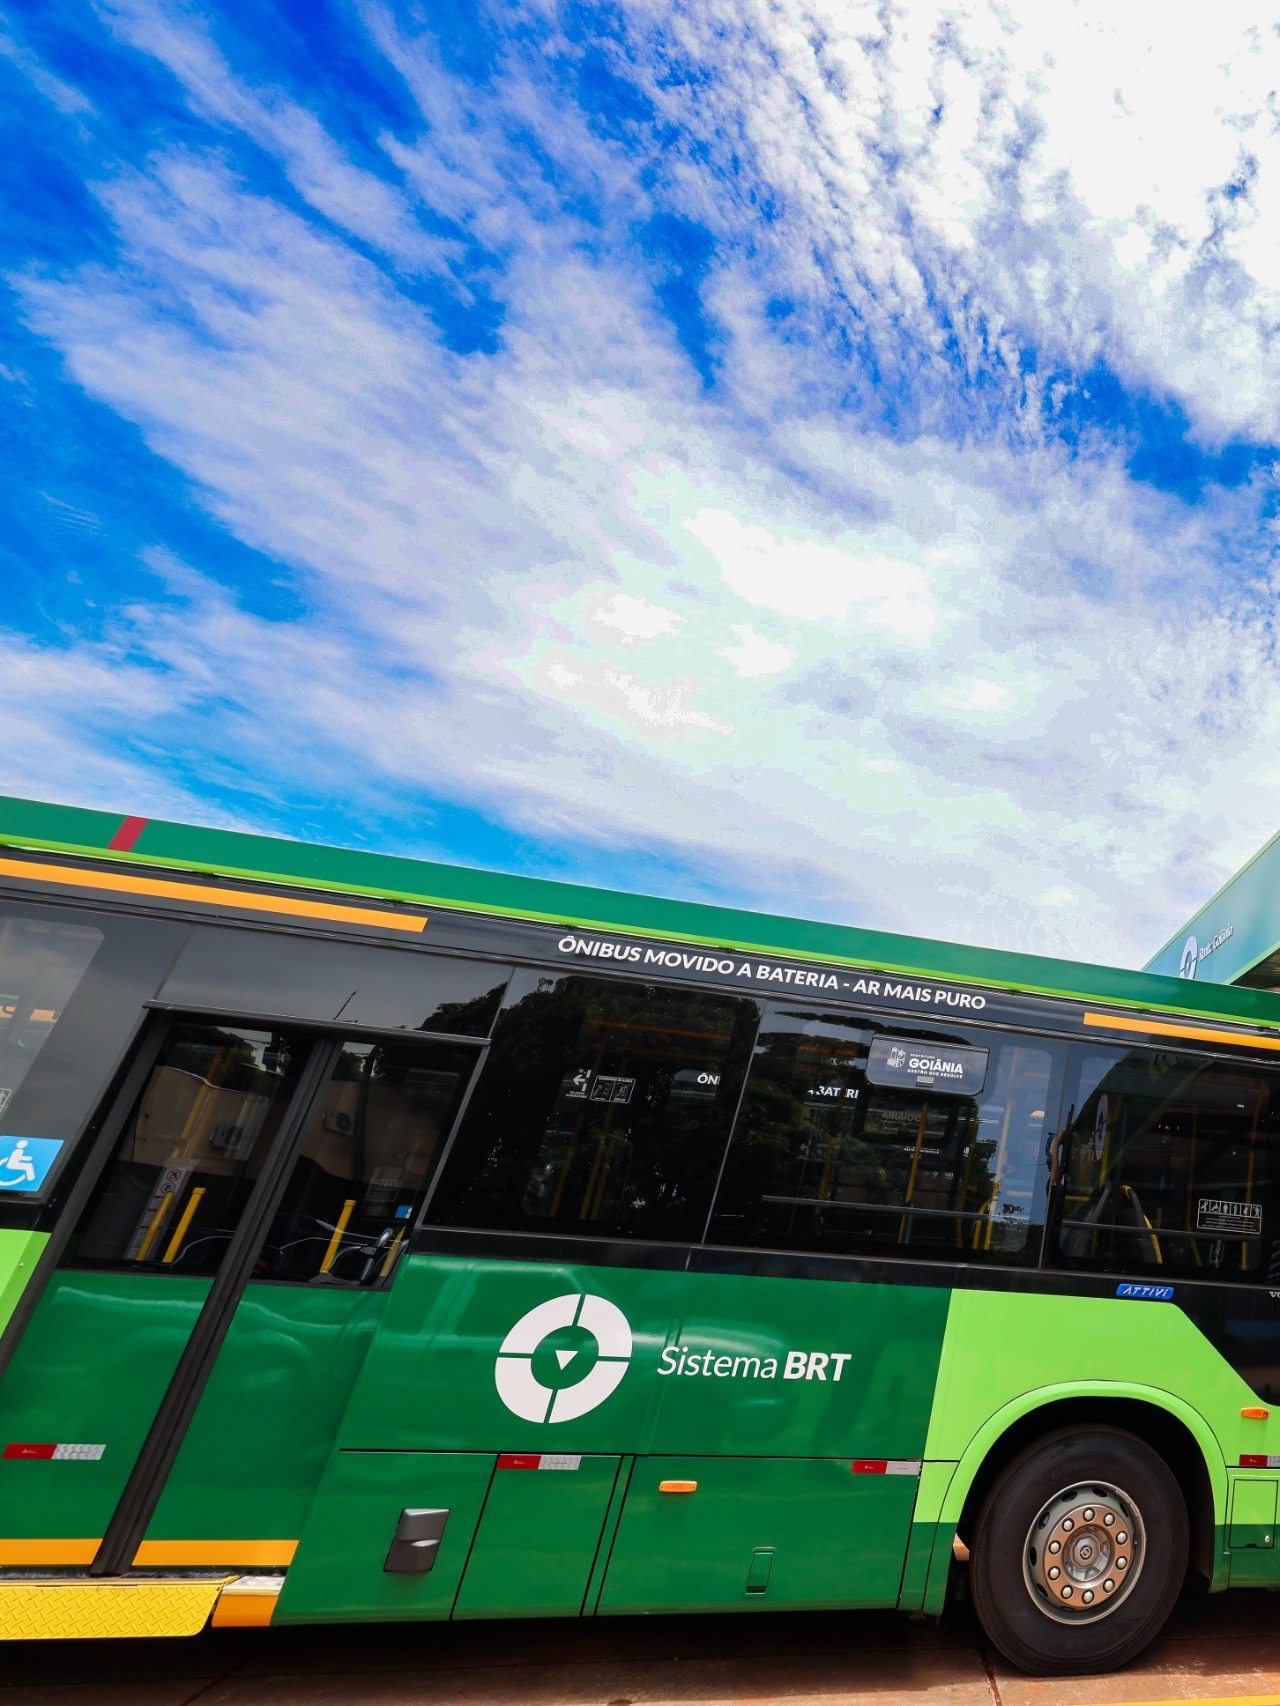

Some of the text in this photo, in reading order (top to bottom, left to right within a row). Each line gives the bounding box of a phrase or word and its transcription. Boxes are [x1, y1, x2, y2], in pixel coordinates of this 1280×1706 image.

[558, 936, 642, 961] ÔNIBUS
[644, 949, 735, 975] MOVIDO
[736, 963, 751, 978] A
[756, 965, 839, 990] BATERIA
[852, 979, 885, 996] AR
[883, 983, 932, 1002] MAIS
[934, 990, 986, 1010] PURO
[909, 1058, 963, 1074] GOIÂNIA
[657, 1346, 852, 1381] Sistema BRT
